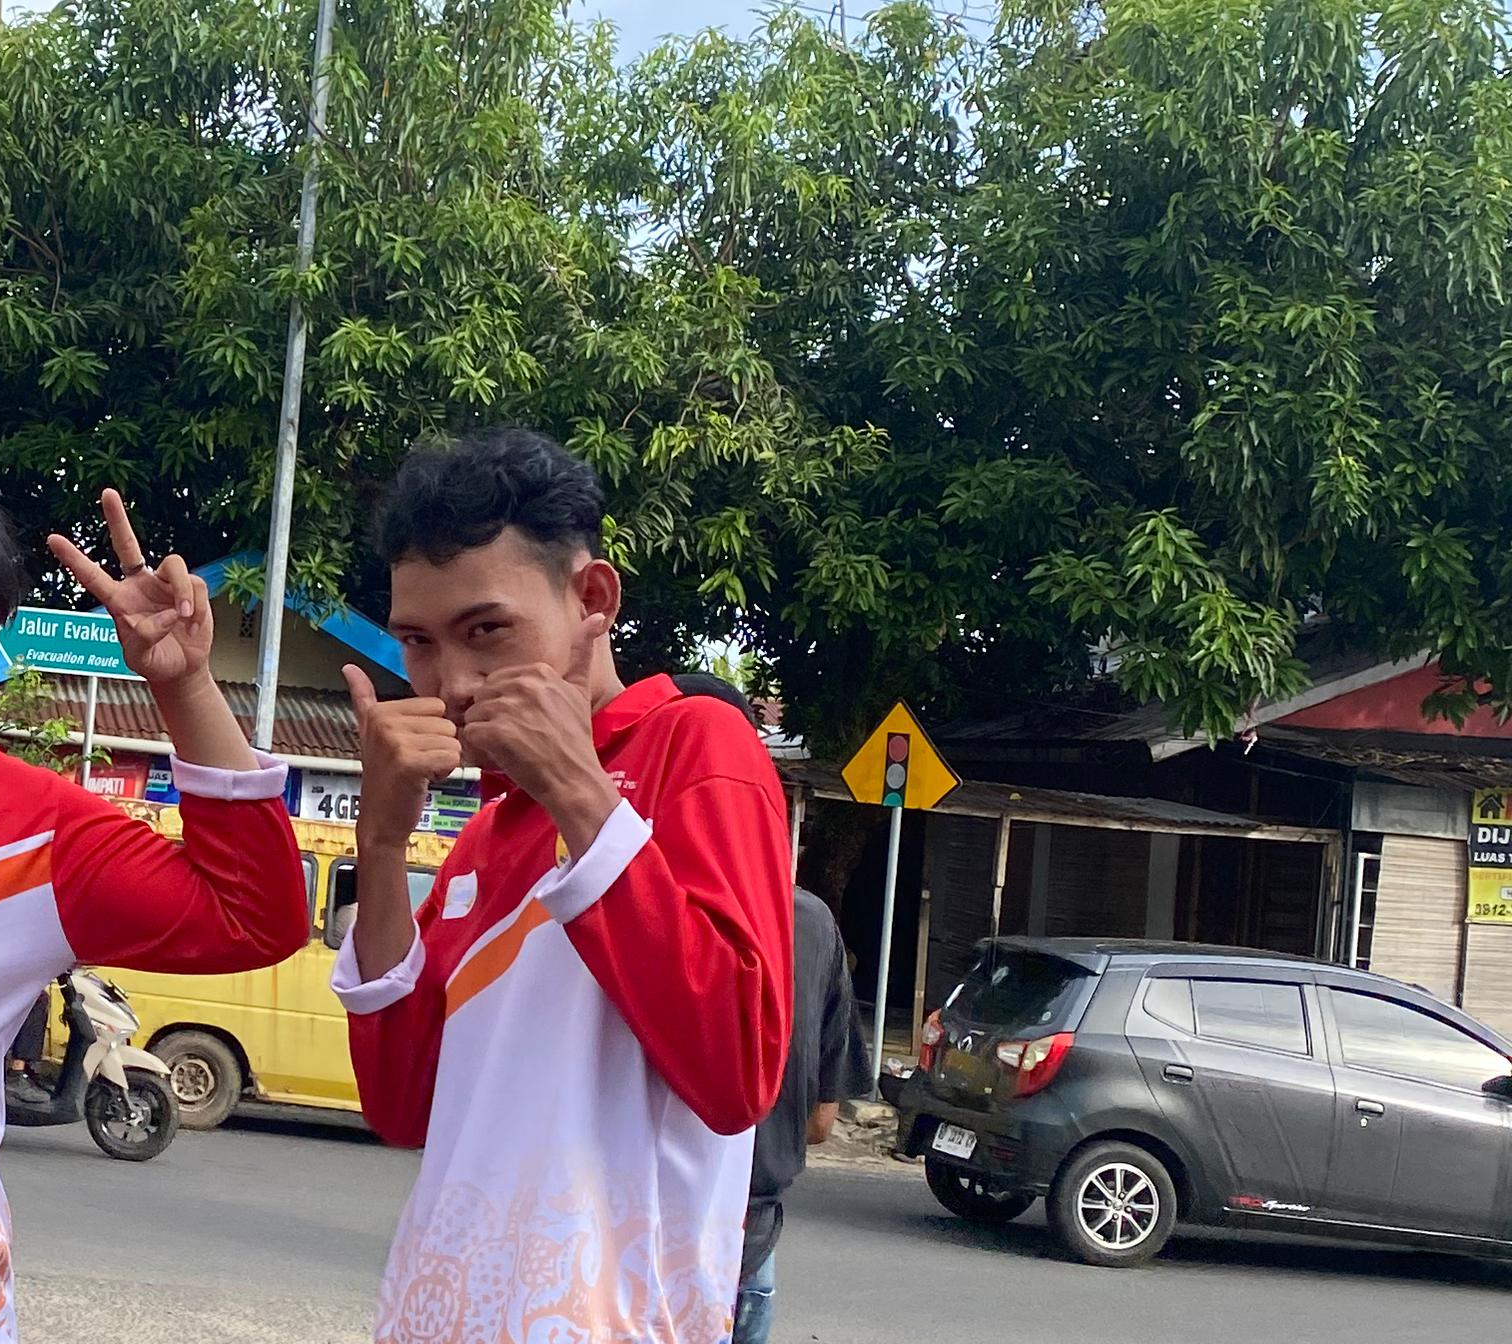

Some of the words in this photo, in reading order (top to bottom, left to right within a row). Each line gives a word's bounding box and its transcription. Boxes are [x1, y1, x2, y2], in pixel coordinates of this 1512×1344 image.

[18, 617, 59, 637] Jalur
[26, 648, 85, 666] Evacuation
[87, 654, 120, 669] Route
[1473, 851, 1506, 863] LUAS
